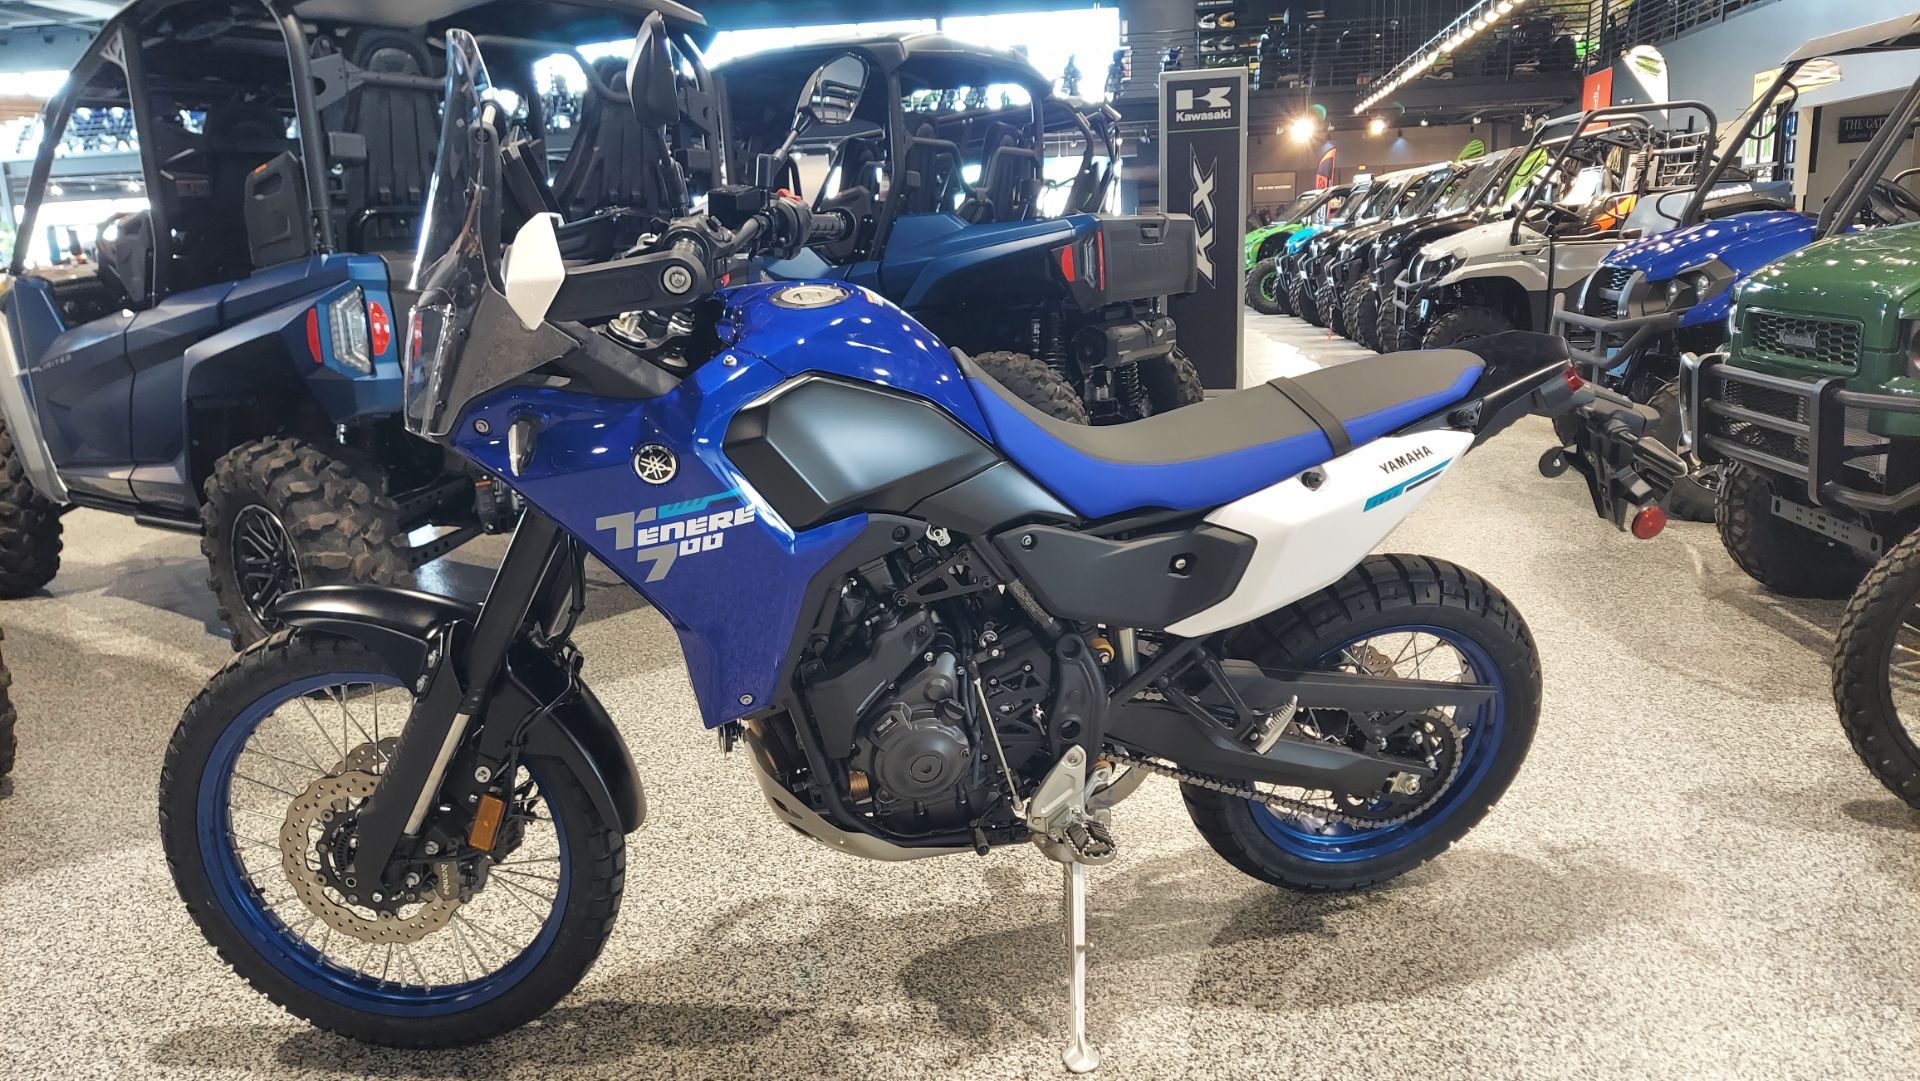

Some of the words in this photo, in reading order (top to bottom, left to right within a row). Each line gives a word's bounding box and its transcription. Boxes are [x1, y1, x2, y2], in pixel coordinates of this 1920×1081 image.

[1175, 108, 1232, 122] Kawasaki
[1378, 445, 1434, 475] YAMAHA
[637, 532, 724, 583] 700
[440, 863, 451, 896] brembo
